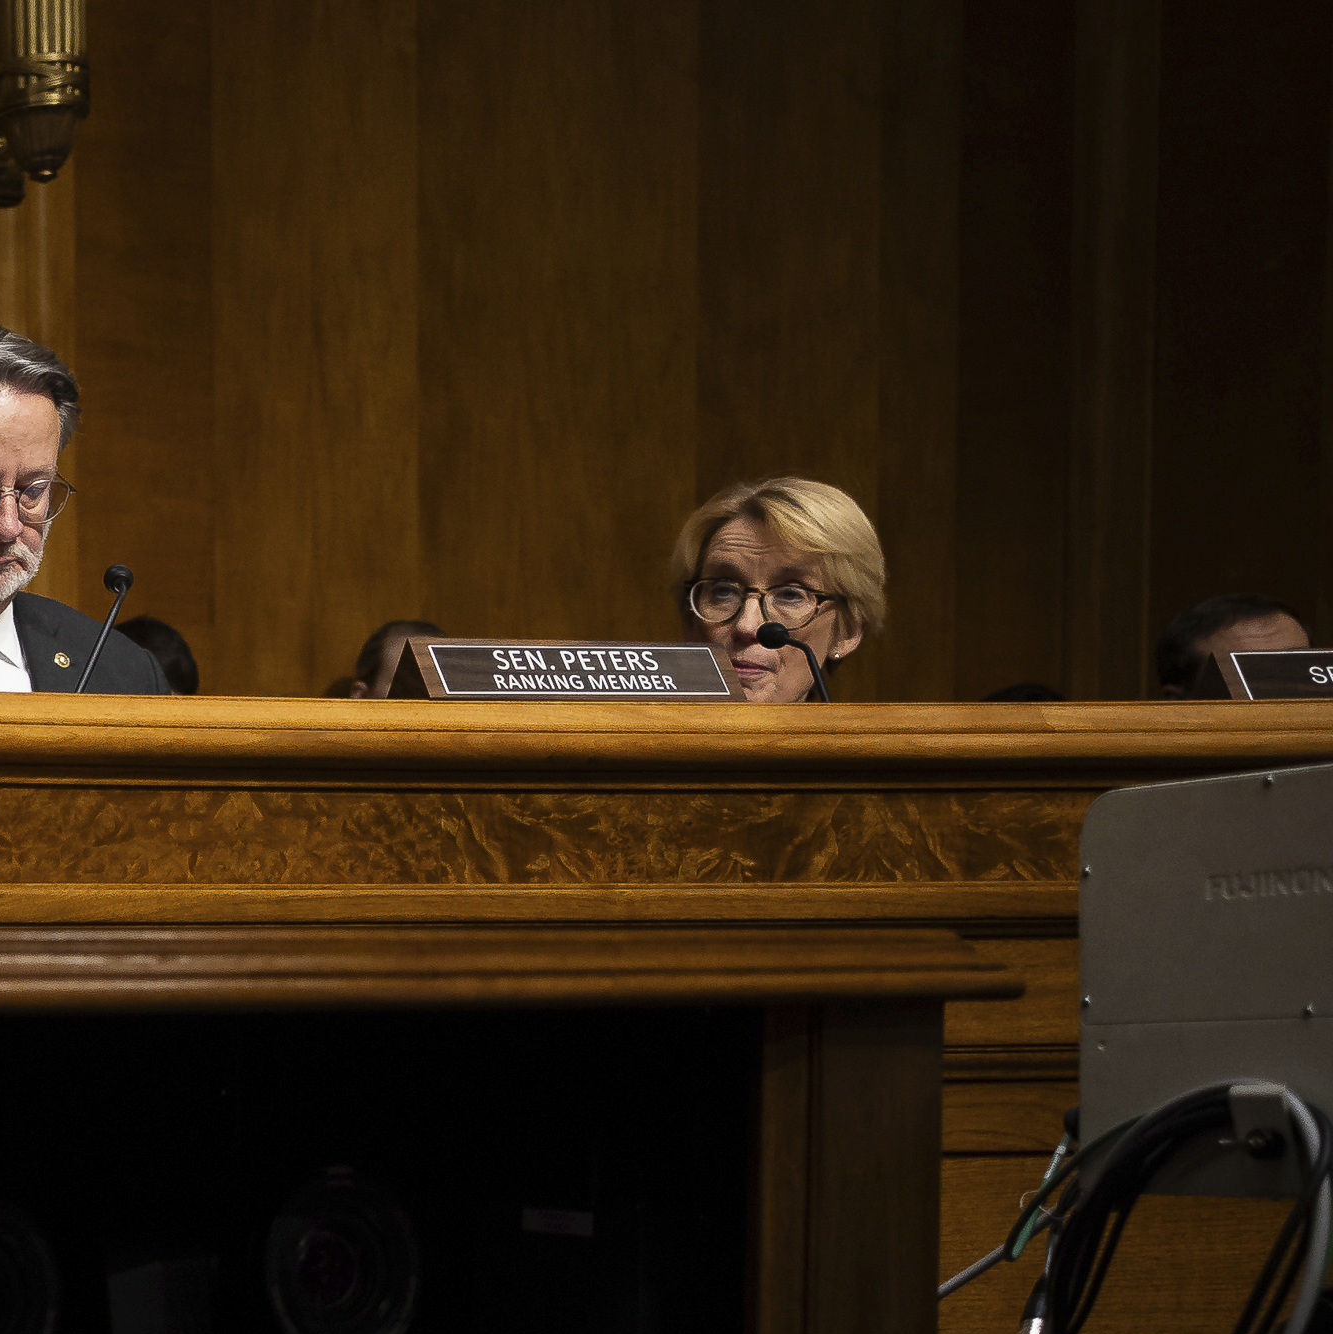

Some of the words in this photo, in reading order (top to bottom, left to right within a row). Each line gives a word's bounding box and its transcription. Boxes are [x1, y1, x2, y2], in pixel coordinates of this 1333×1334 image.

[492, 649, 556, 671] SEN.
[560, 650, 660, 672] PETERS
[493, 674, 585, 691] RANKING
[588, 675, 678, 691] MEMBER
